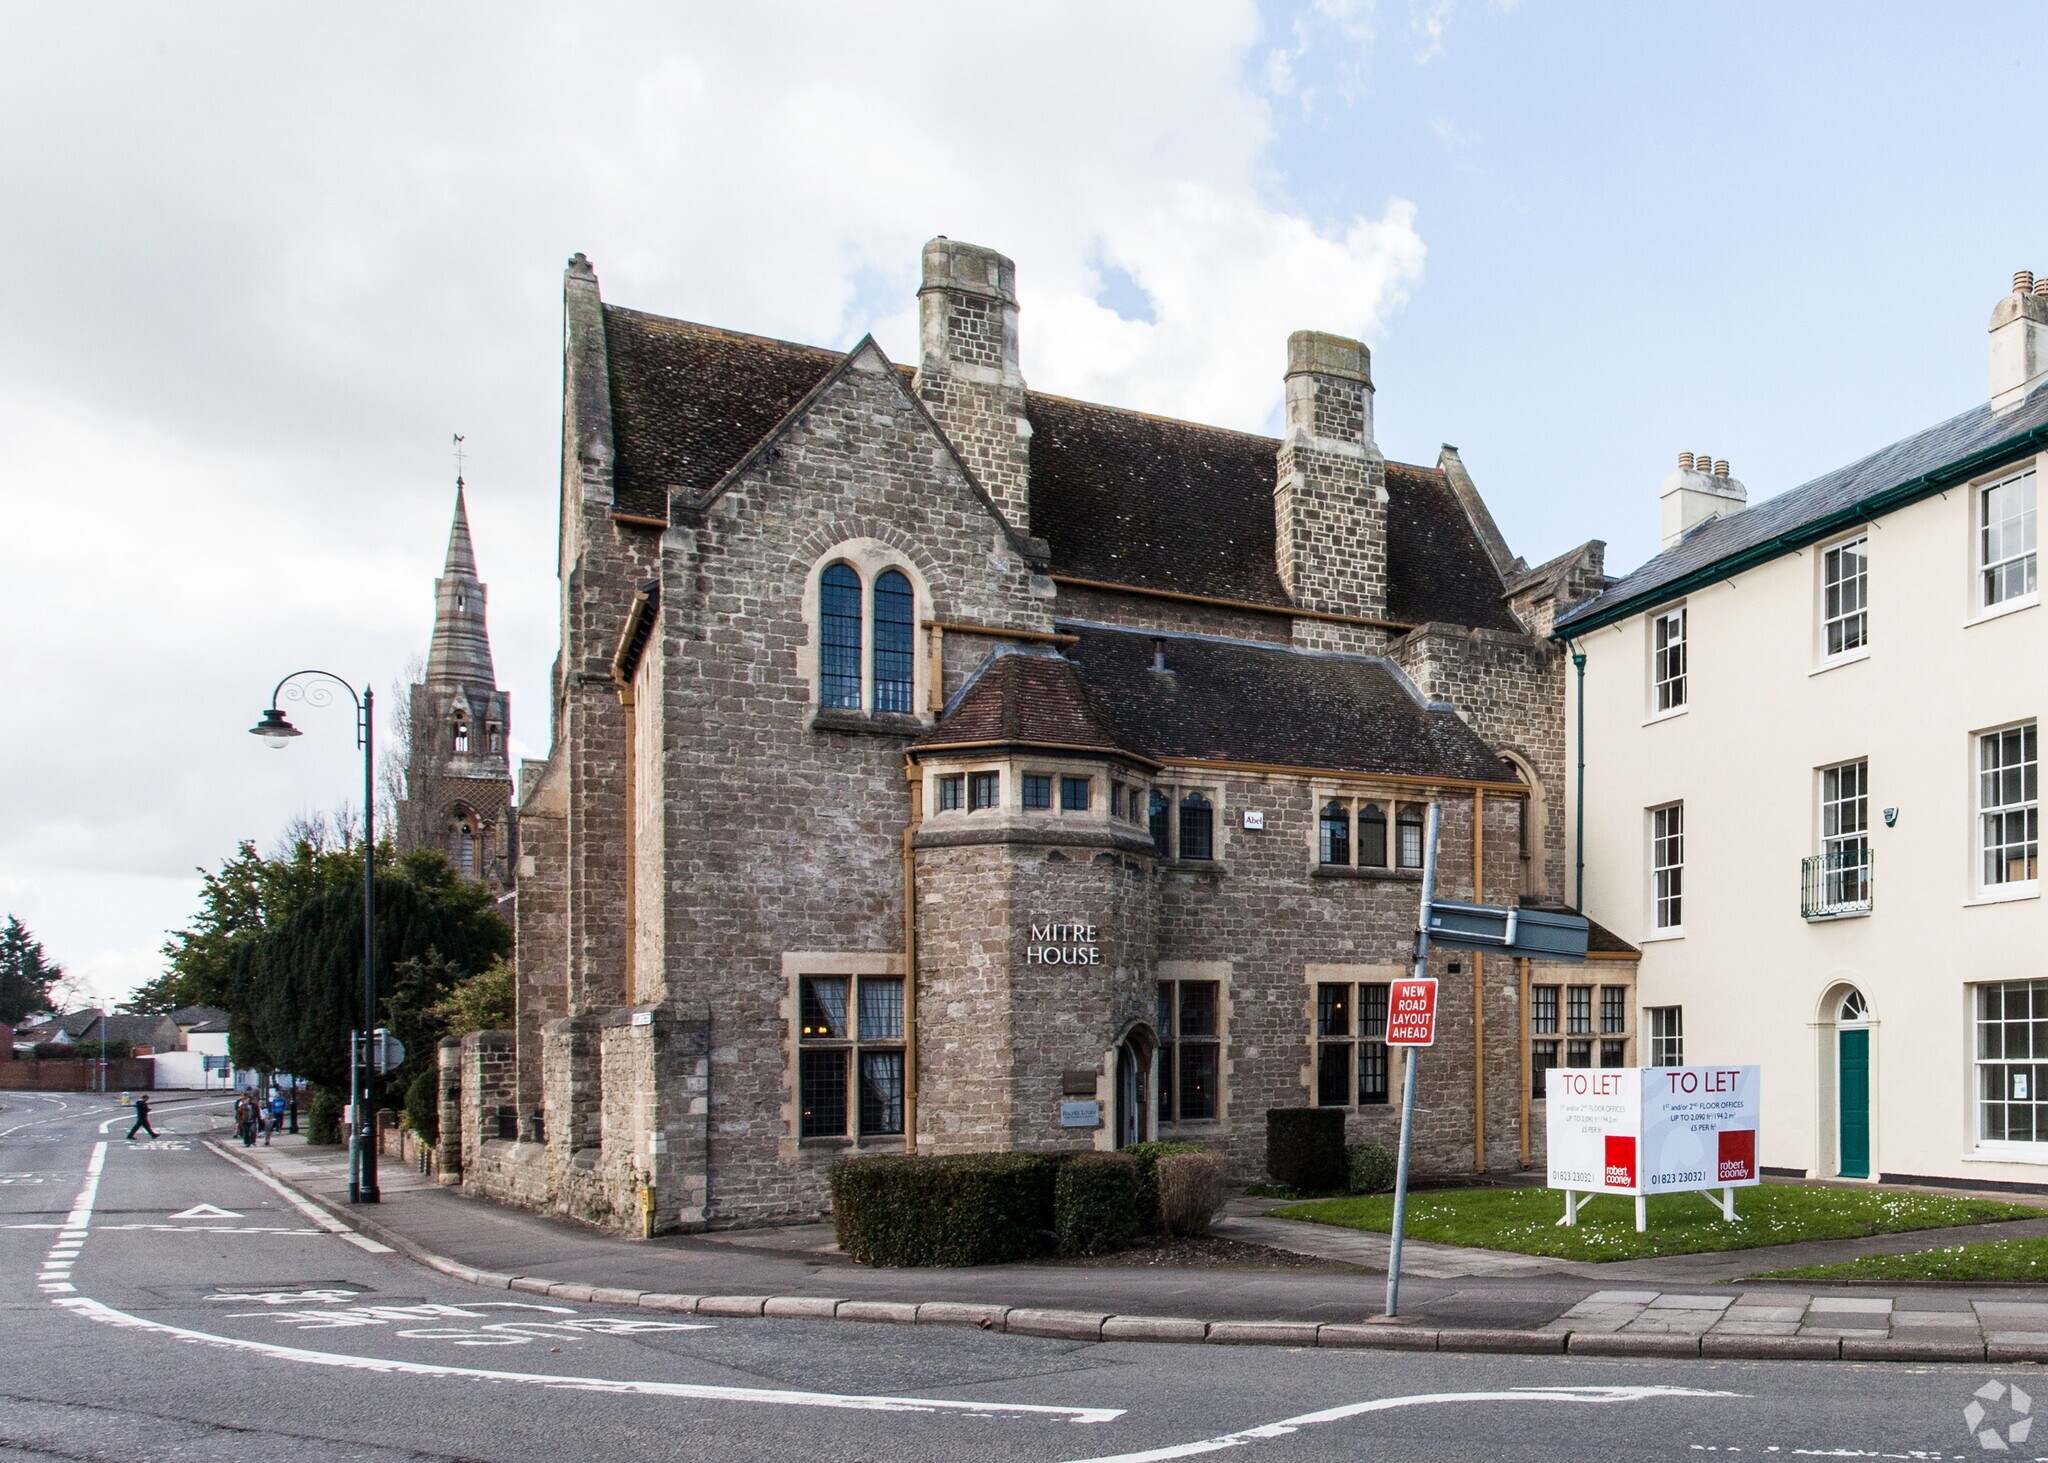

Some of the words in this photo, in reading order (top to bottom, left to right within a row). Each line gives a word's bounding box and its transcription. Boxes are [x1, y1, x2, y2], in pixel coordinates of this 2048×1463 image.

[1246, 816, 1263, 825] Abel
[1031, 923, 1097, 943] MITRE
[1027, 946, 1100, 965] HOUSE
[1402, 986, 1426, 998] NEW
[1398, 999, 1427, 1011] ROAD
[1392, 1013, 1431, 1025] LAYOUT
[1392, 1027, 1428, 1038] AHEAD
[1563, 1074, 1588, 1095] TO
[1592, 1074, 1622, 1096] LET
[1666, 1072, 1698, 1094] TO
[1705, 1071, 1741, 1093] LET
[1588, 1105, 1605, 1113] FLOOR
[1606, 1105, 1626, 1113] OFFICES
[1670, 1103, 1688, 1111] and/or
[1699, 1102, 1720, 1110] FLOOR
[1720, 1101, 1744, 1109] OFFICES
[1573, 1115, 1582, 1123] TO
[1670, 1114, 1680, 1122] UP
[1680, 1113, 1690, 1121] TO
[1690, 1113, 1705, 1121] 2,090
[1588, 1126, 1597, 1134] PER
[1690, 1124, 1698, 1132] £5
[1698, 1124, 1710, 1132] PER
[1606, 1165, 1628, 1176] robert
[1720, 1160, 1744, 1170] robert
[1552, 1170, 1571, 1182] 01823
[1573, 1171, 1595, 1183] 230321
[1651, 1172, 1676, 1185] 01823
[1678, 1171, 1706, 1183] 230321
[1720, 1169, 1749, 1179] cooney
[1606, 1175, 1632, 1187] cooney
